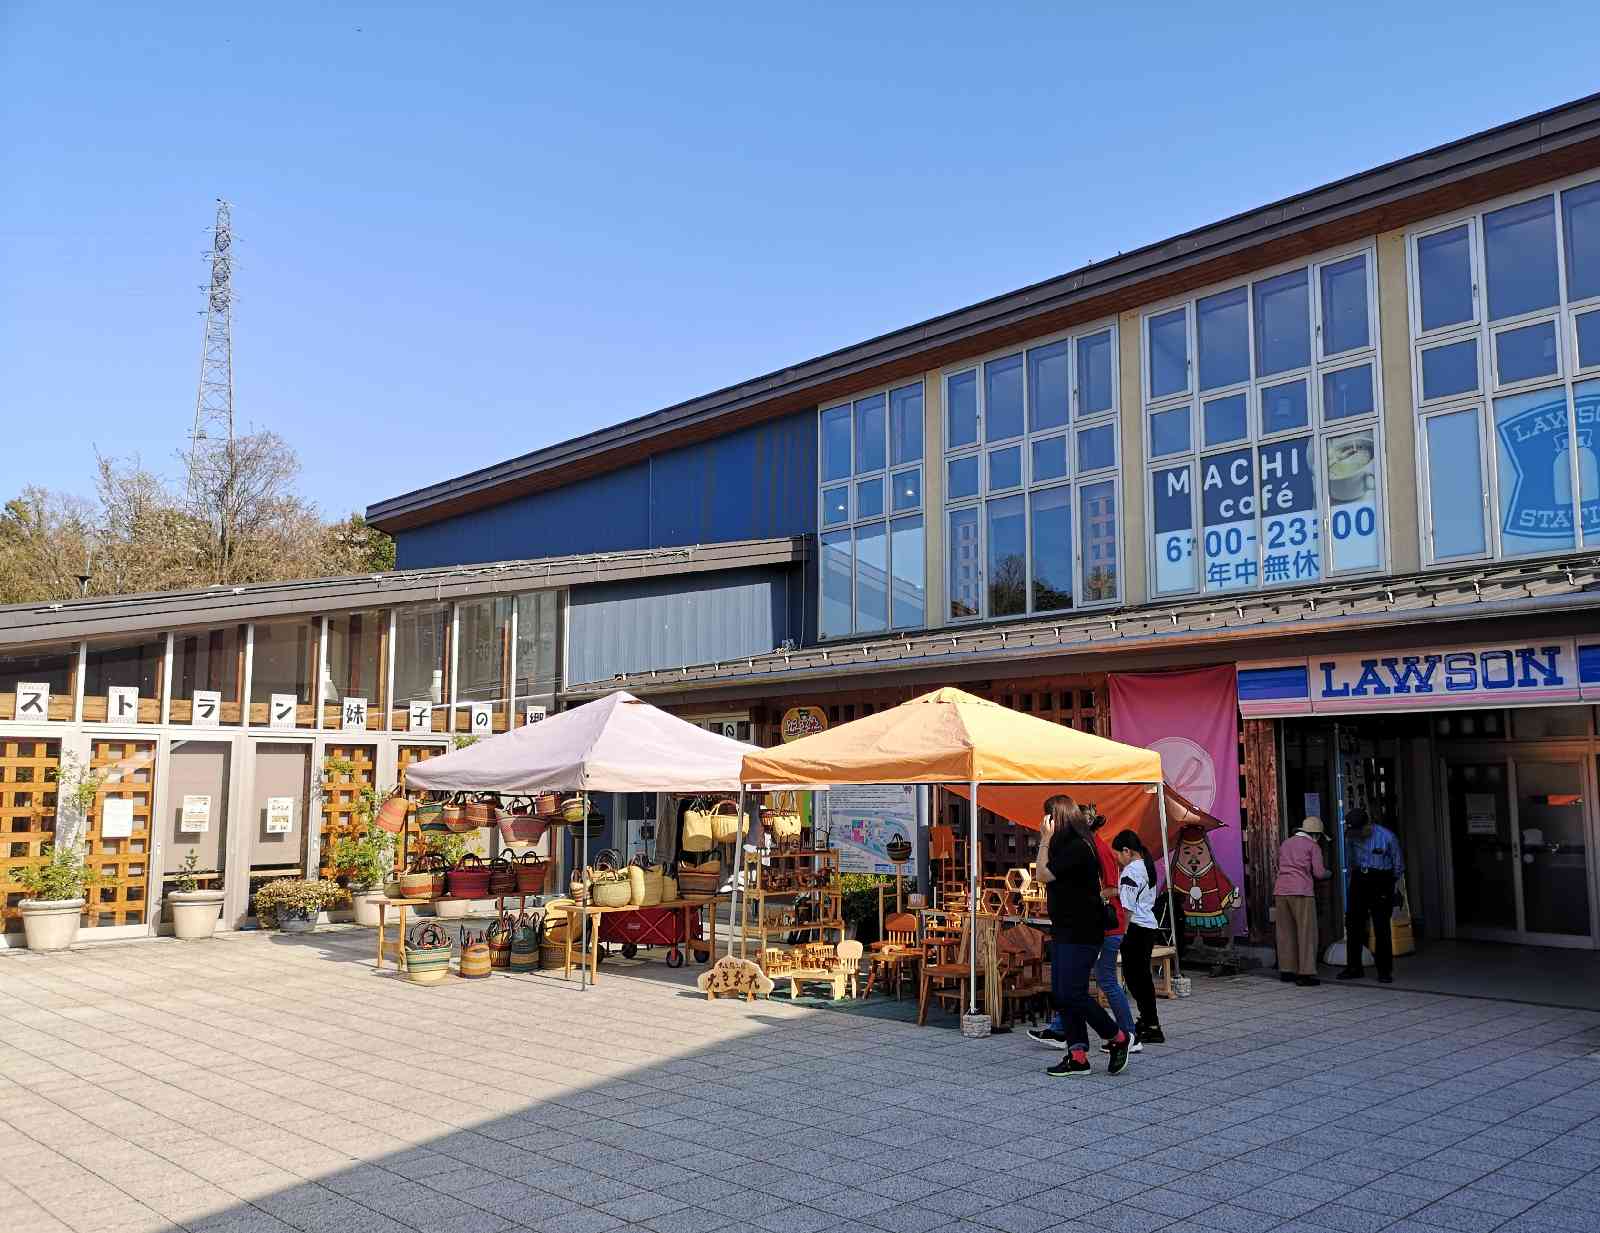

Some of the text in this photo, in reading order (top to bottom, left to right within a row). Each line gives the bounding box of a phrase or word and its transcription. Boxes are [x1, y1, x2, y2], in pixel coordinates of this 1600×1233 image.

[1512, 405, 1600, 443] LAWS
[1167, 447, 1299, 497] MACHI
[1219, 481, 1293, 518] café
[1207, 549, 1320, 588] 年中無休
[1319, 646, 1564, 698] LAWSON
